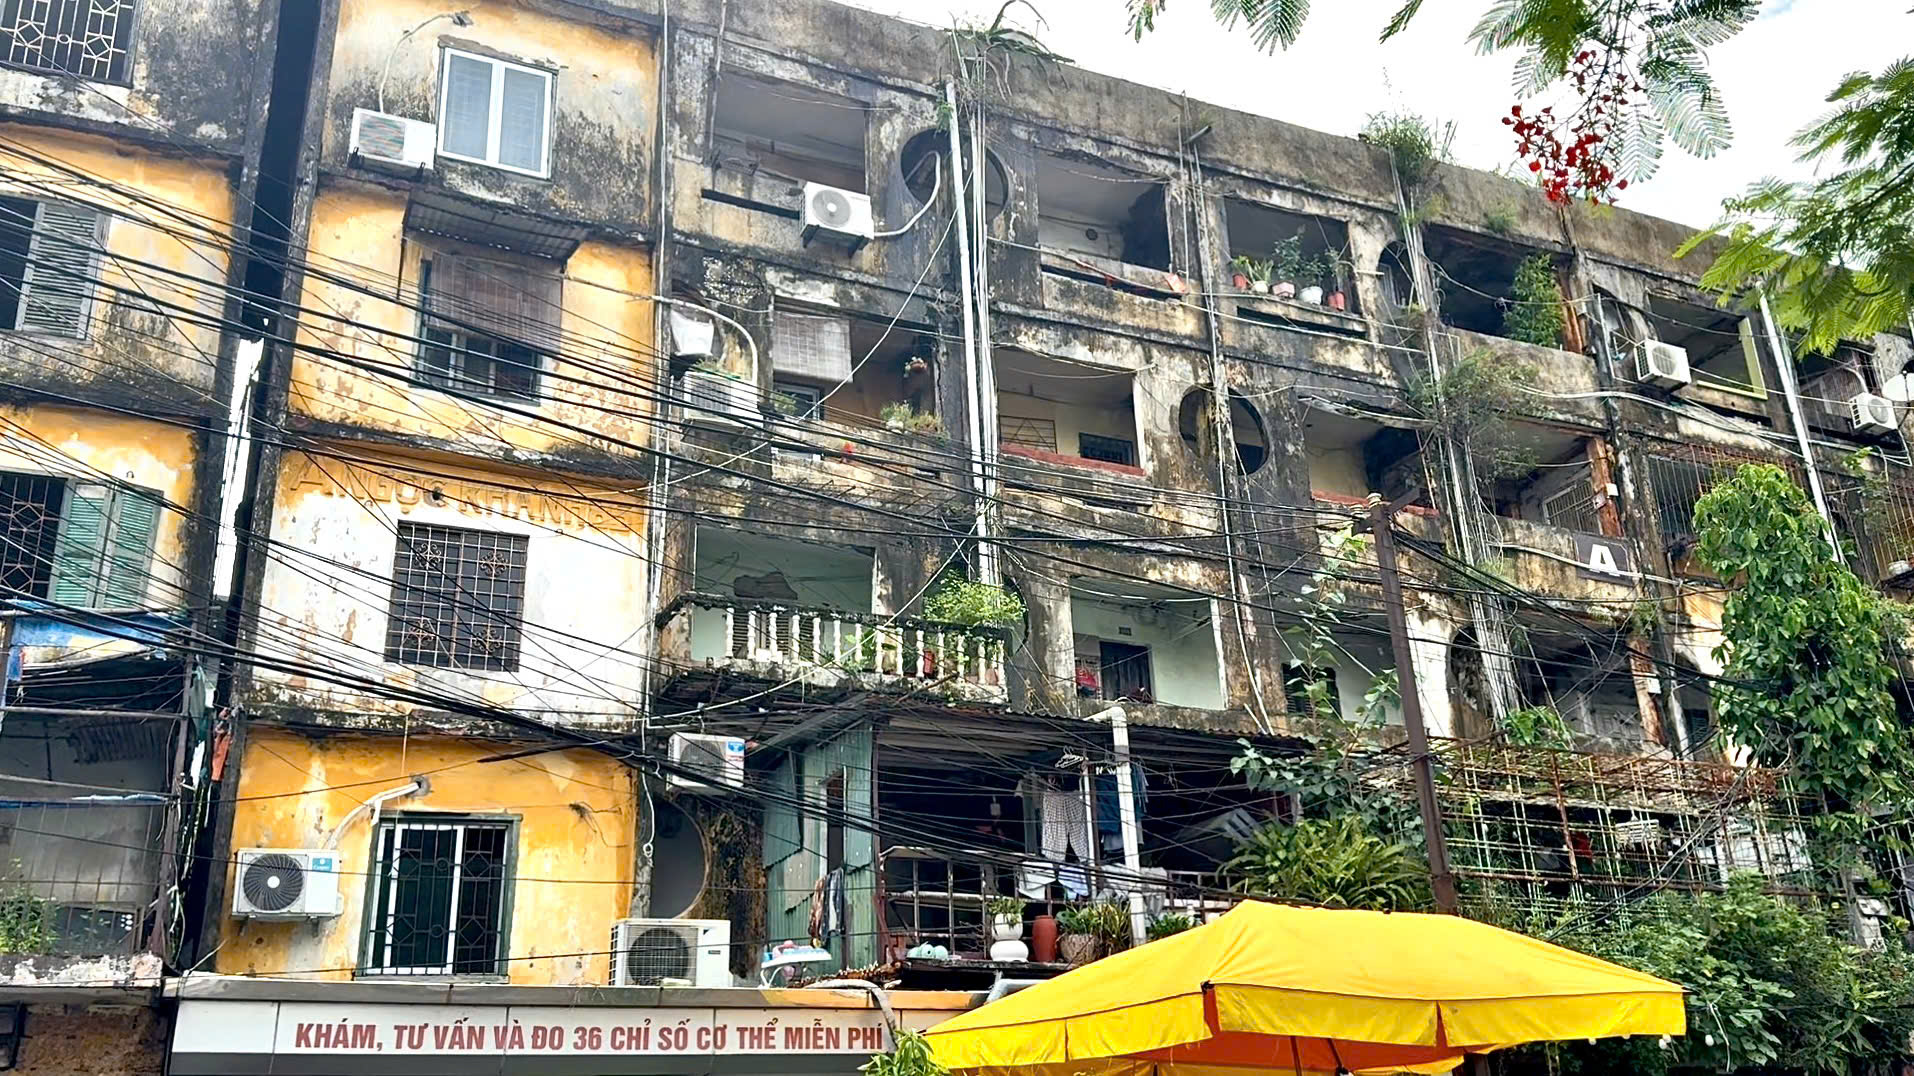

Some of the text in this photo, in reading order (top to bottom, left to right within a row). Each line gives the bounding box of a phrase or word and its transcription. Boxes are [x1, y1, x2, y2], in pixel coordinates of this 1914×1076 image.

[1589, 543, 1621, 577] A
[295, 1017, 884, 1052] KHÁM, TƯ VẤN VÀ ĐO 36 CHỈ SỐ CƠ THỂ MIỄN PHÍ
